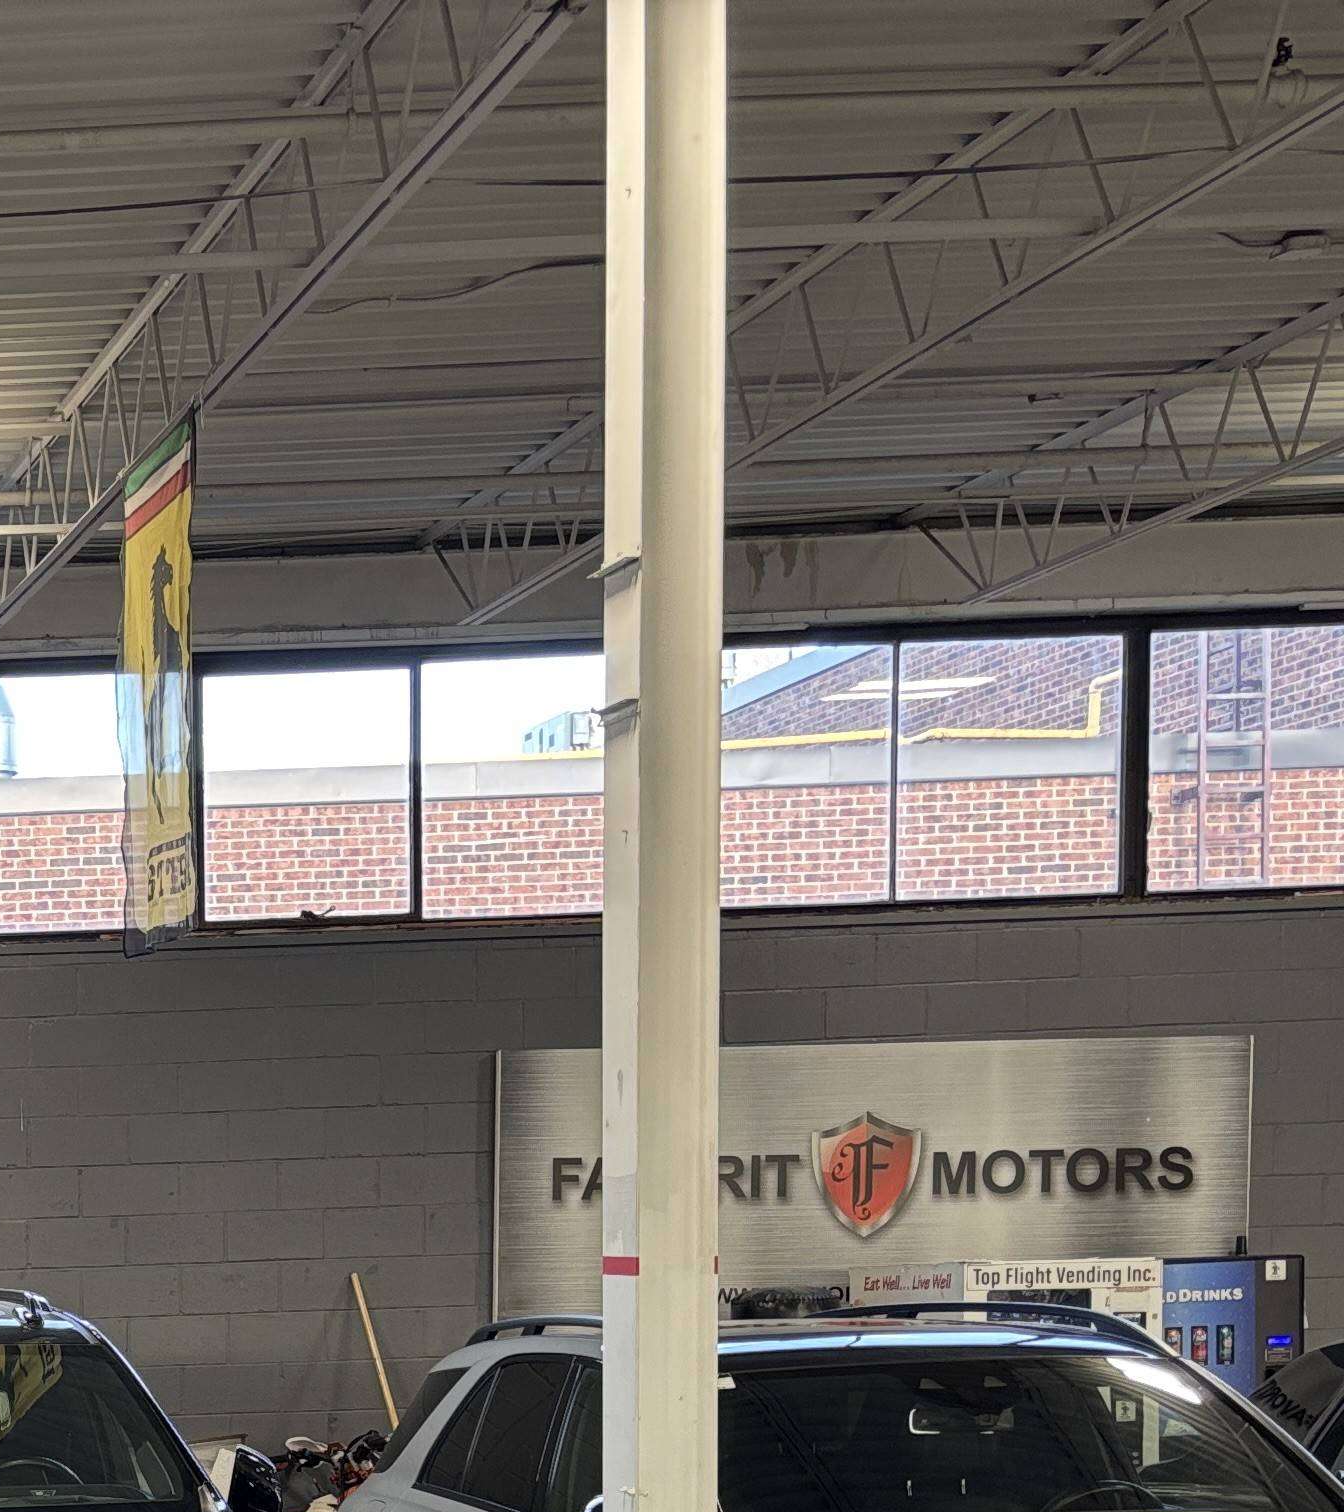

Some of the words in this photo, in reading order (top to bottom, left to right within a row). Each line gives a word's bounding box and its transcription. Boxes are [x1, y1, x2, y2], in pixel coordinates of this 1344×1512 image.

[931, 1146, 1194, 1195] MOTORS
[863, 1276, 880, 1291] Eat
[912, 1274, 930, 1290] Live
[973, 1268, 1000, 1288] Top
[1006, 1267, 1052, 1288] Flight
[1056, 1265, 1122, 1286] Vending
[1127, 1265, 1156, 1282] Inc.
[1179, 1287, 1244, 1302] DRINKS
